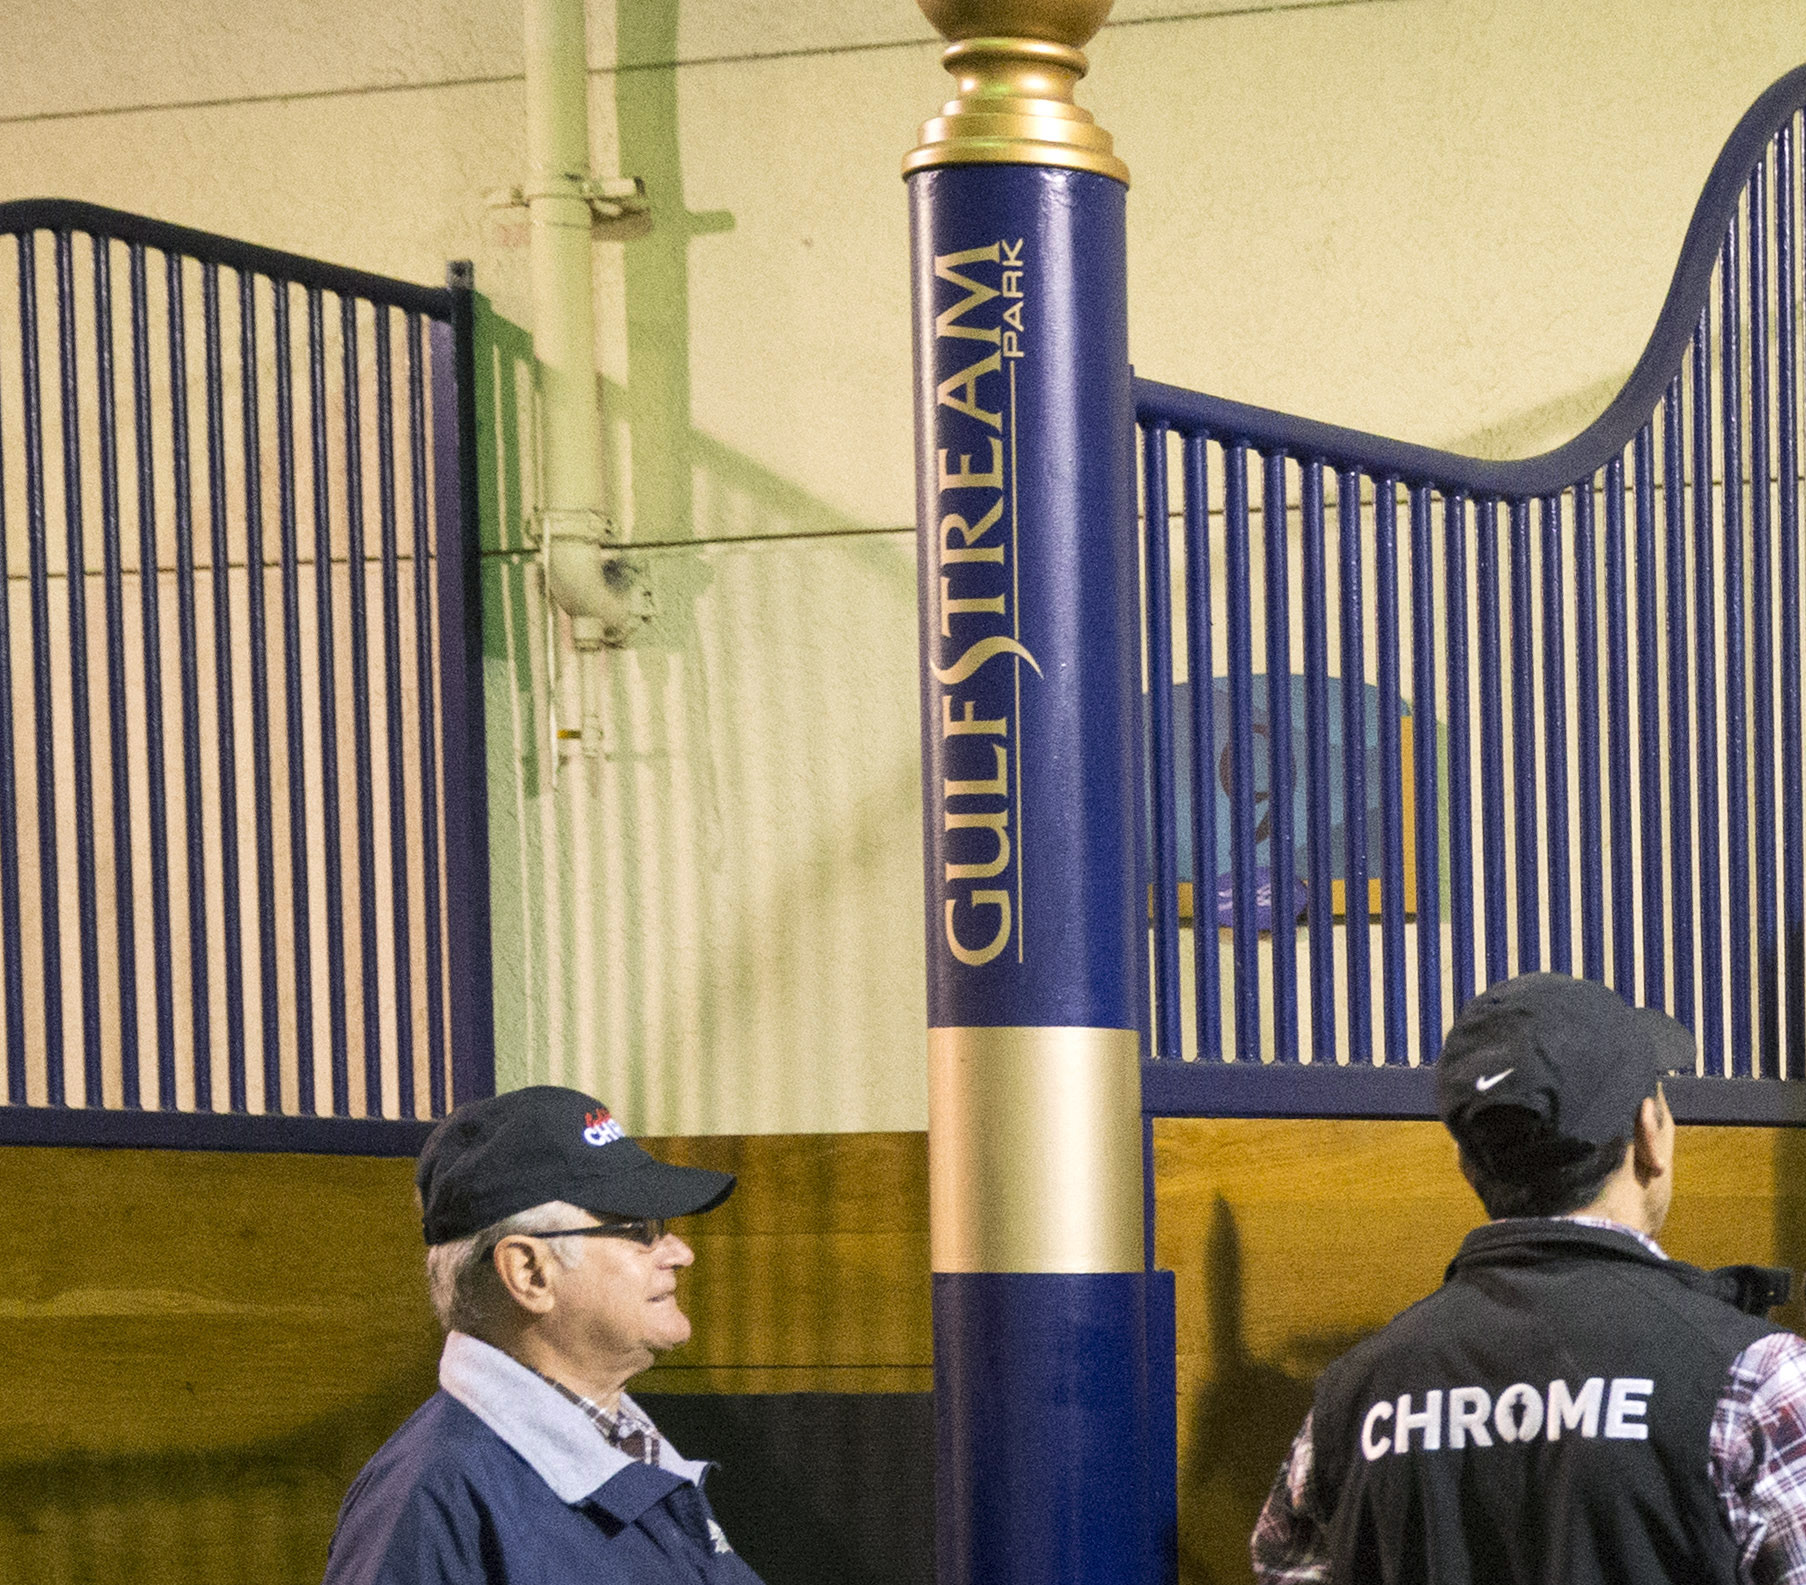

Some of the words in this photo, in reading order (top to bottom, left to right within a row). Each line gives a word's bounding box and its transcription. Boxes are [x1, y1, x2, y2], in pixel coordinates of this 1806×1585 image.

[1001, 237, 1025, 359] PARK
[931, 240, 1044, 966] GULFSTREAM
[1360, 1376, 1655, 1462] CHROME
